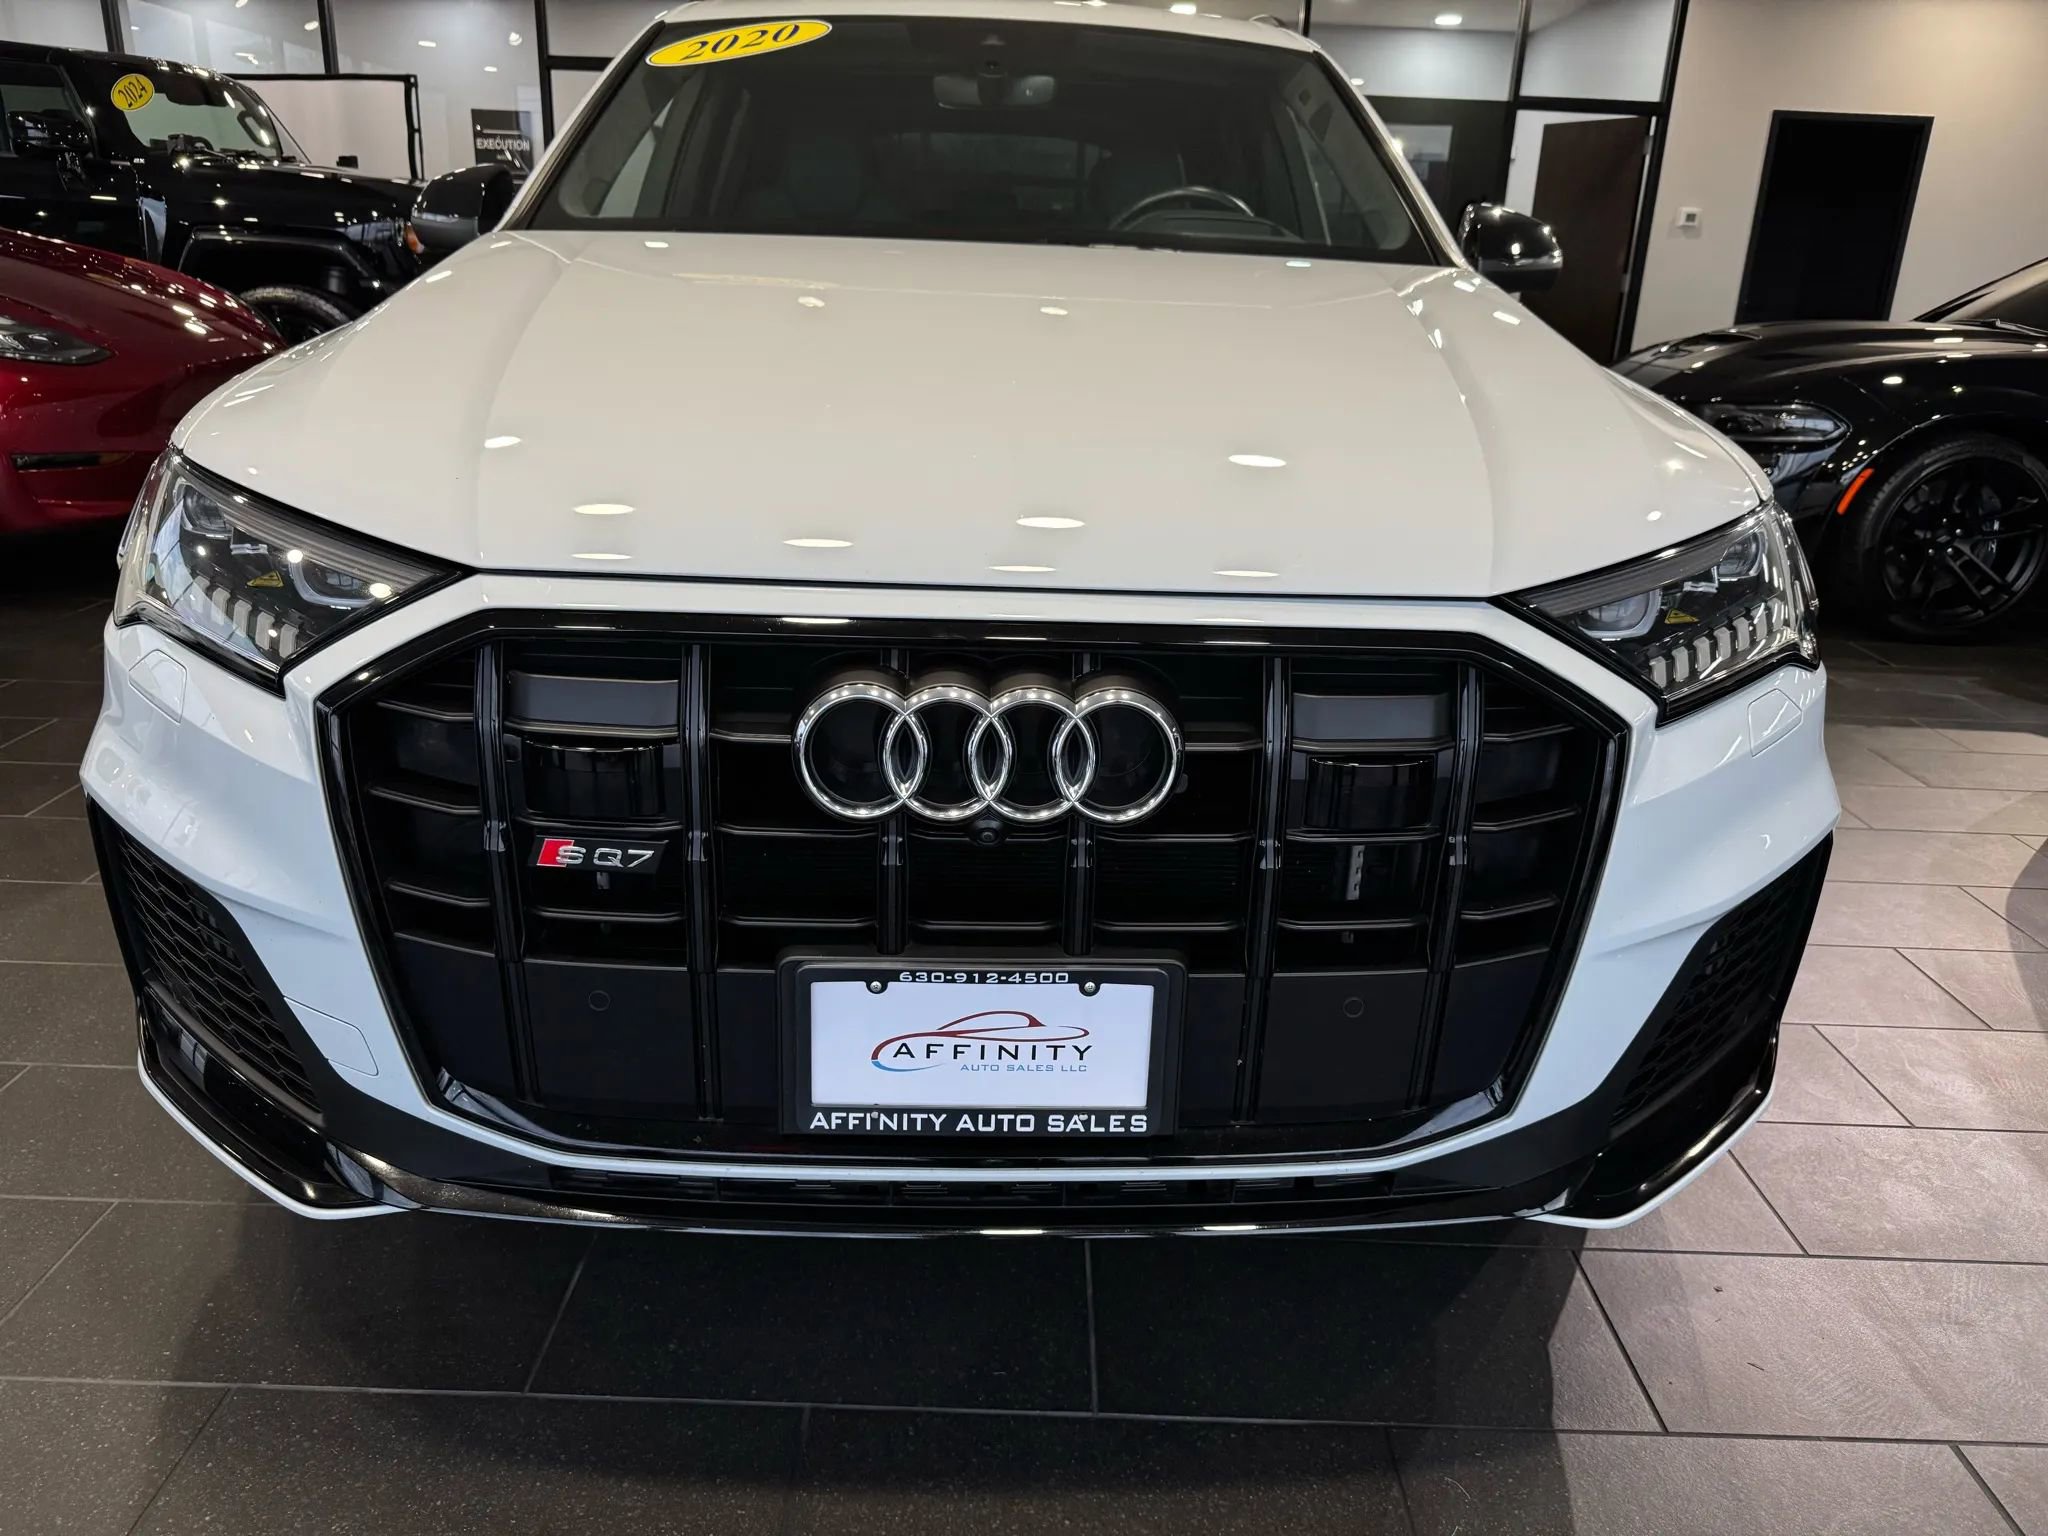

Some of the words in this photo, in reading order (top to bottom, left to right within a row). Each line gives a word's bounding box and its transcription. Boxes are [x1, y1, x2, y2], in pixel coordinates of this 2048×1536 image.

[679, 24, 800, 61] 2020
[118, 76, 148, 108] 2024
[476, 137, 530, 151] EXECUTION
[899, 971, 1069, 984] 630-912-4500
[892, 1042, 1092, 1061] AFFINITY
[960, 1064, 999, 1072] AUTO
[1006, 1064, 1054, 1072] SALES
[809, 1111, 948, 1132] AFFINITY
[955, 1113, 1036, 1132] AUTO
[1046, 1114, 1148, 1133] SALES
